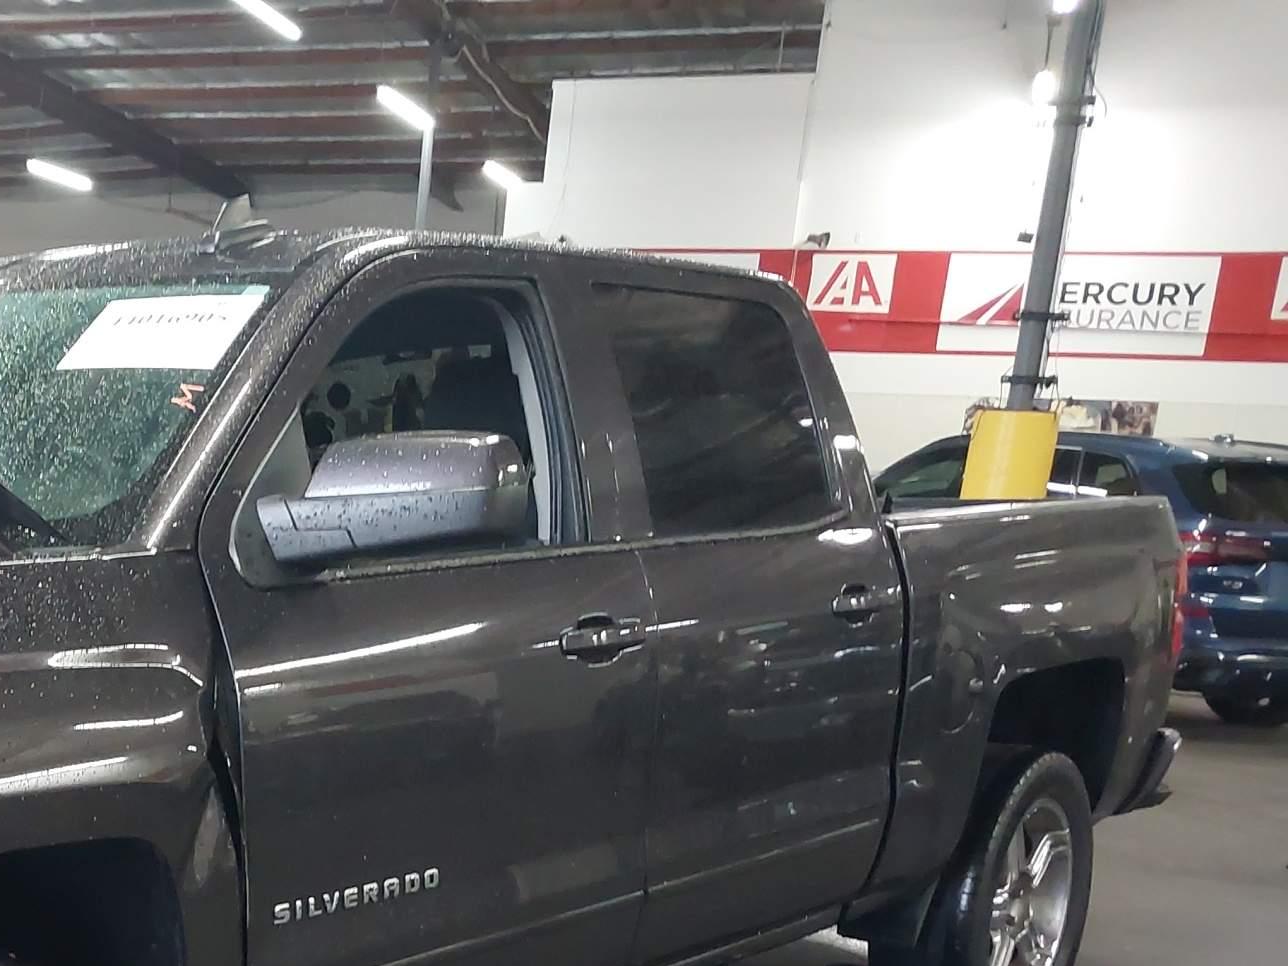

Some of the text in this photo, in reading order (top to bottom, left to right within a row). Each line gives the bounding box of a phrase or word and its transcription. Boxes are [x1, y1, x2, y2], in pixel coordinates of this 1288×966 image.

[1059, 281, 1206, 306] ERCURY
[1064, 308, 1203, 331] URANCE
[273, 867, 441, 926] SILVERADO
